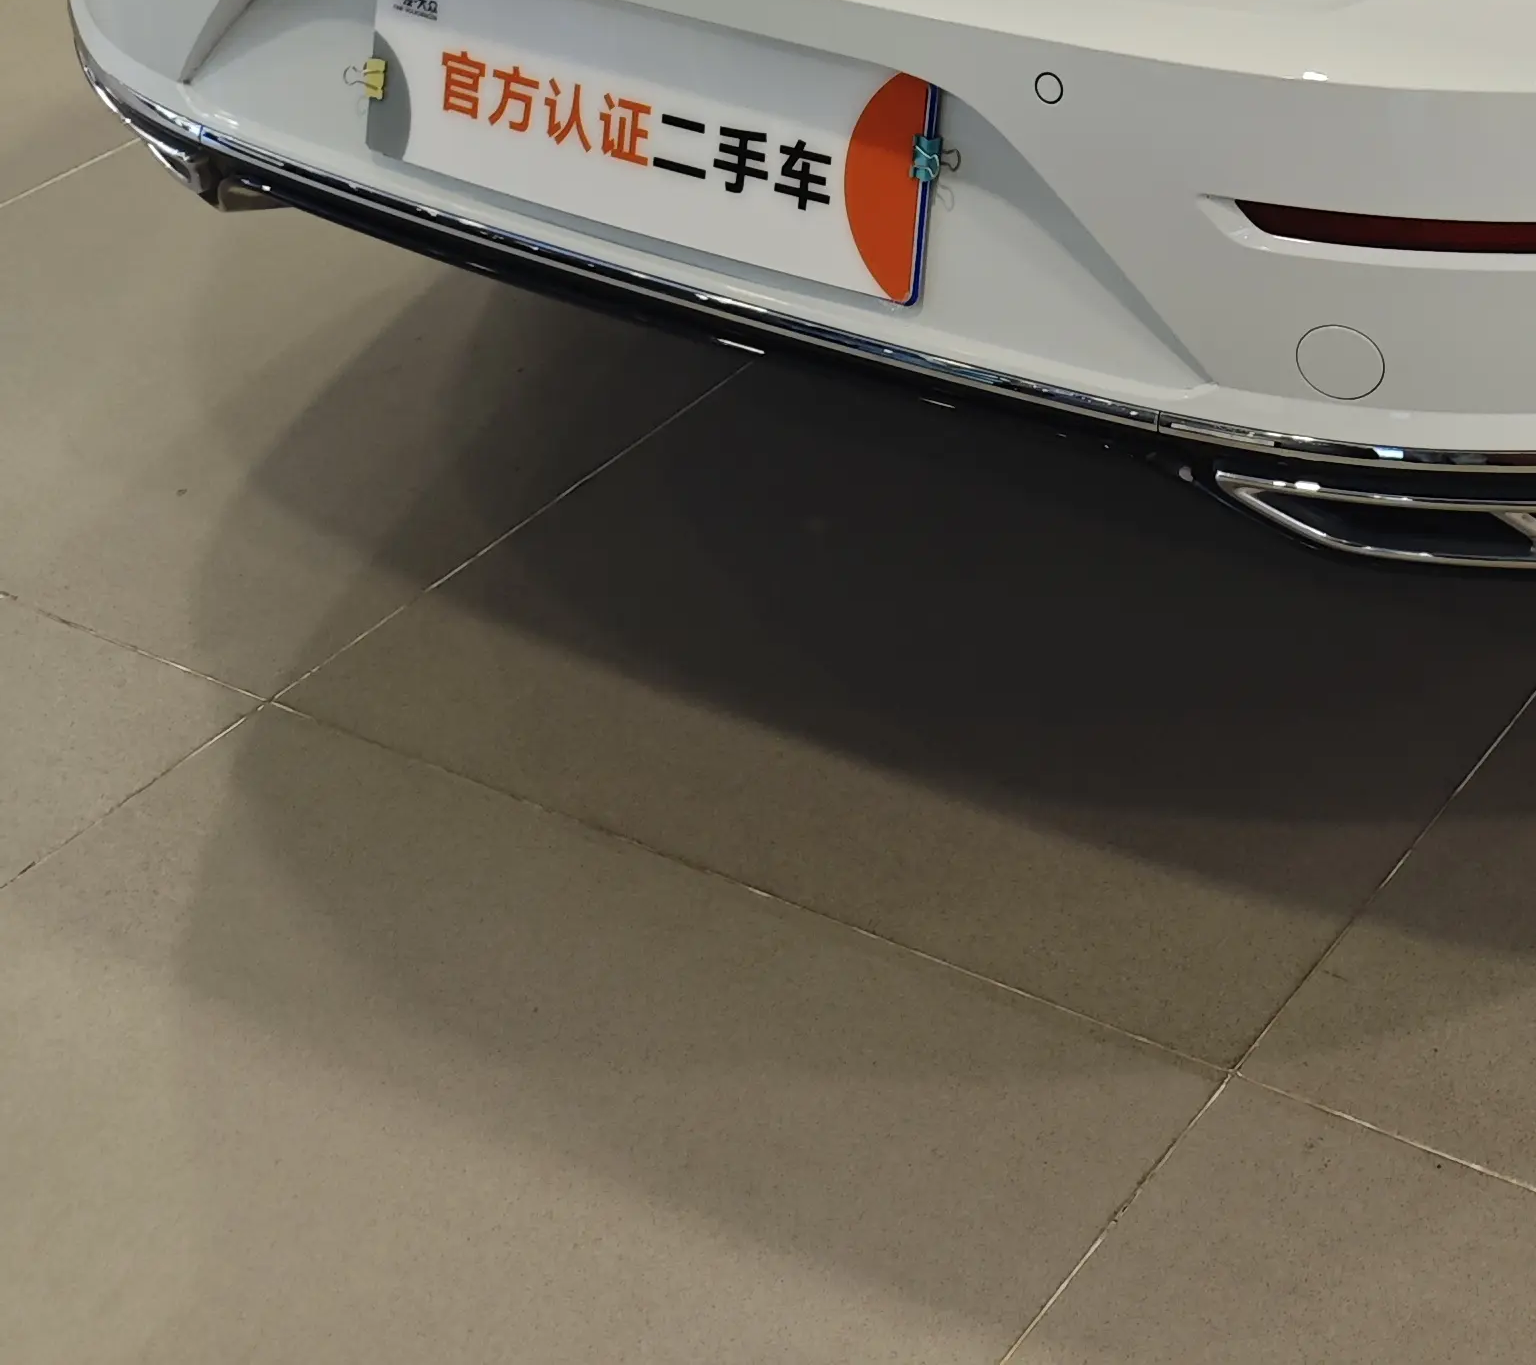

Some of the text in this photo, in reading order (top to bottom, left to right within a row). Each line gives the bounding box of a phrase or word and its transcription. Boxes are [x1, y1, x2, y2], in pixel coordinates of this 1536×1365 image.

[441, 50, 832, 211] 官方认证二手车
